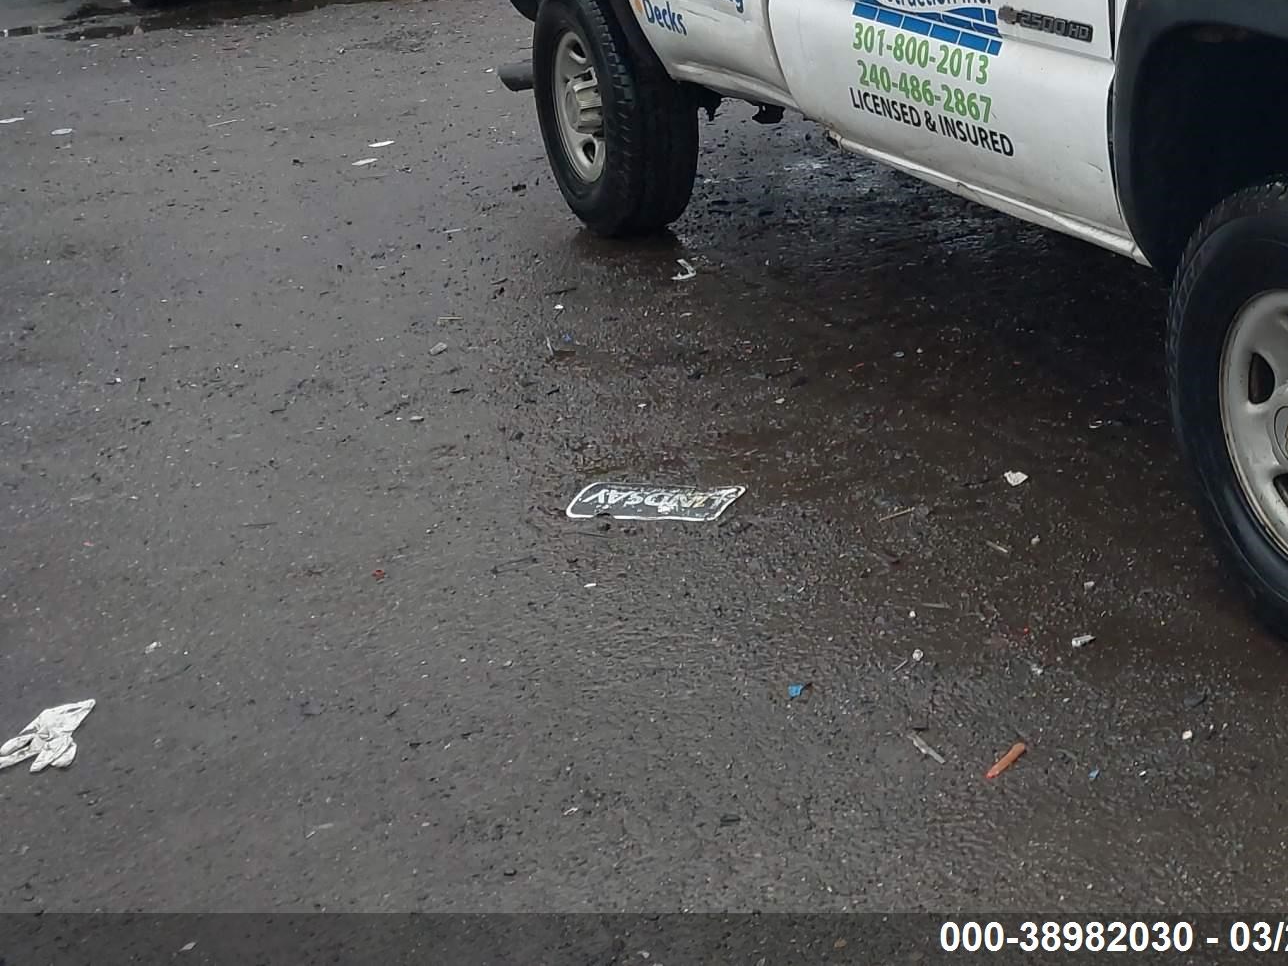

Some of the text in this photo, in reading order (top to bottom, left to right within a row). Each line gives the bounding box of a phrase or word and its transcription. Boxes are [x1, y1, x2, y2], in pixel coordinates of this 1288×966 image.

[853, 22, 989, 85] 301-800-2013
[850, 87, 1014, 157] LICENSED & INSURED
[857, 59, 992, 124] 240-486-2867
